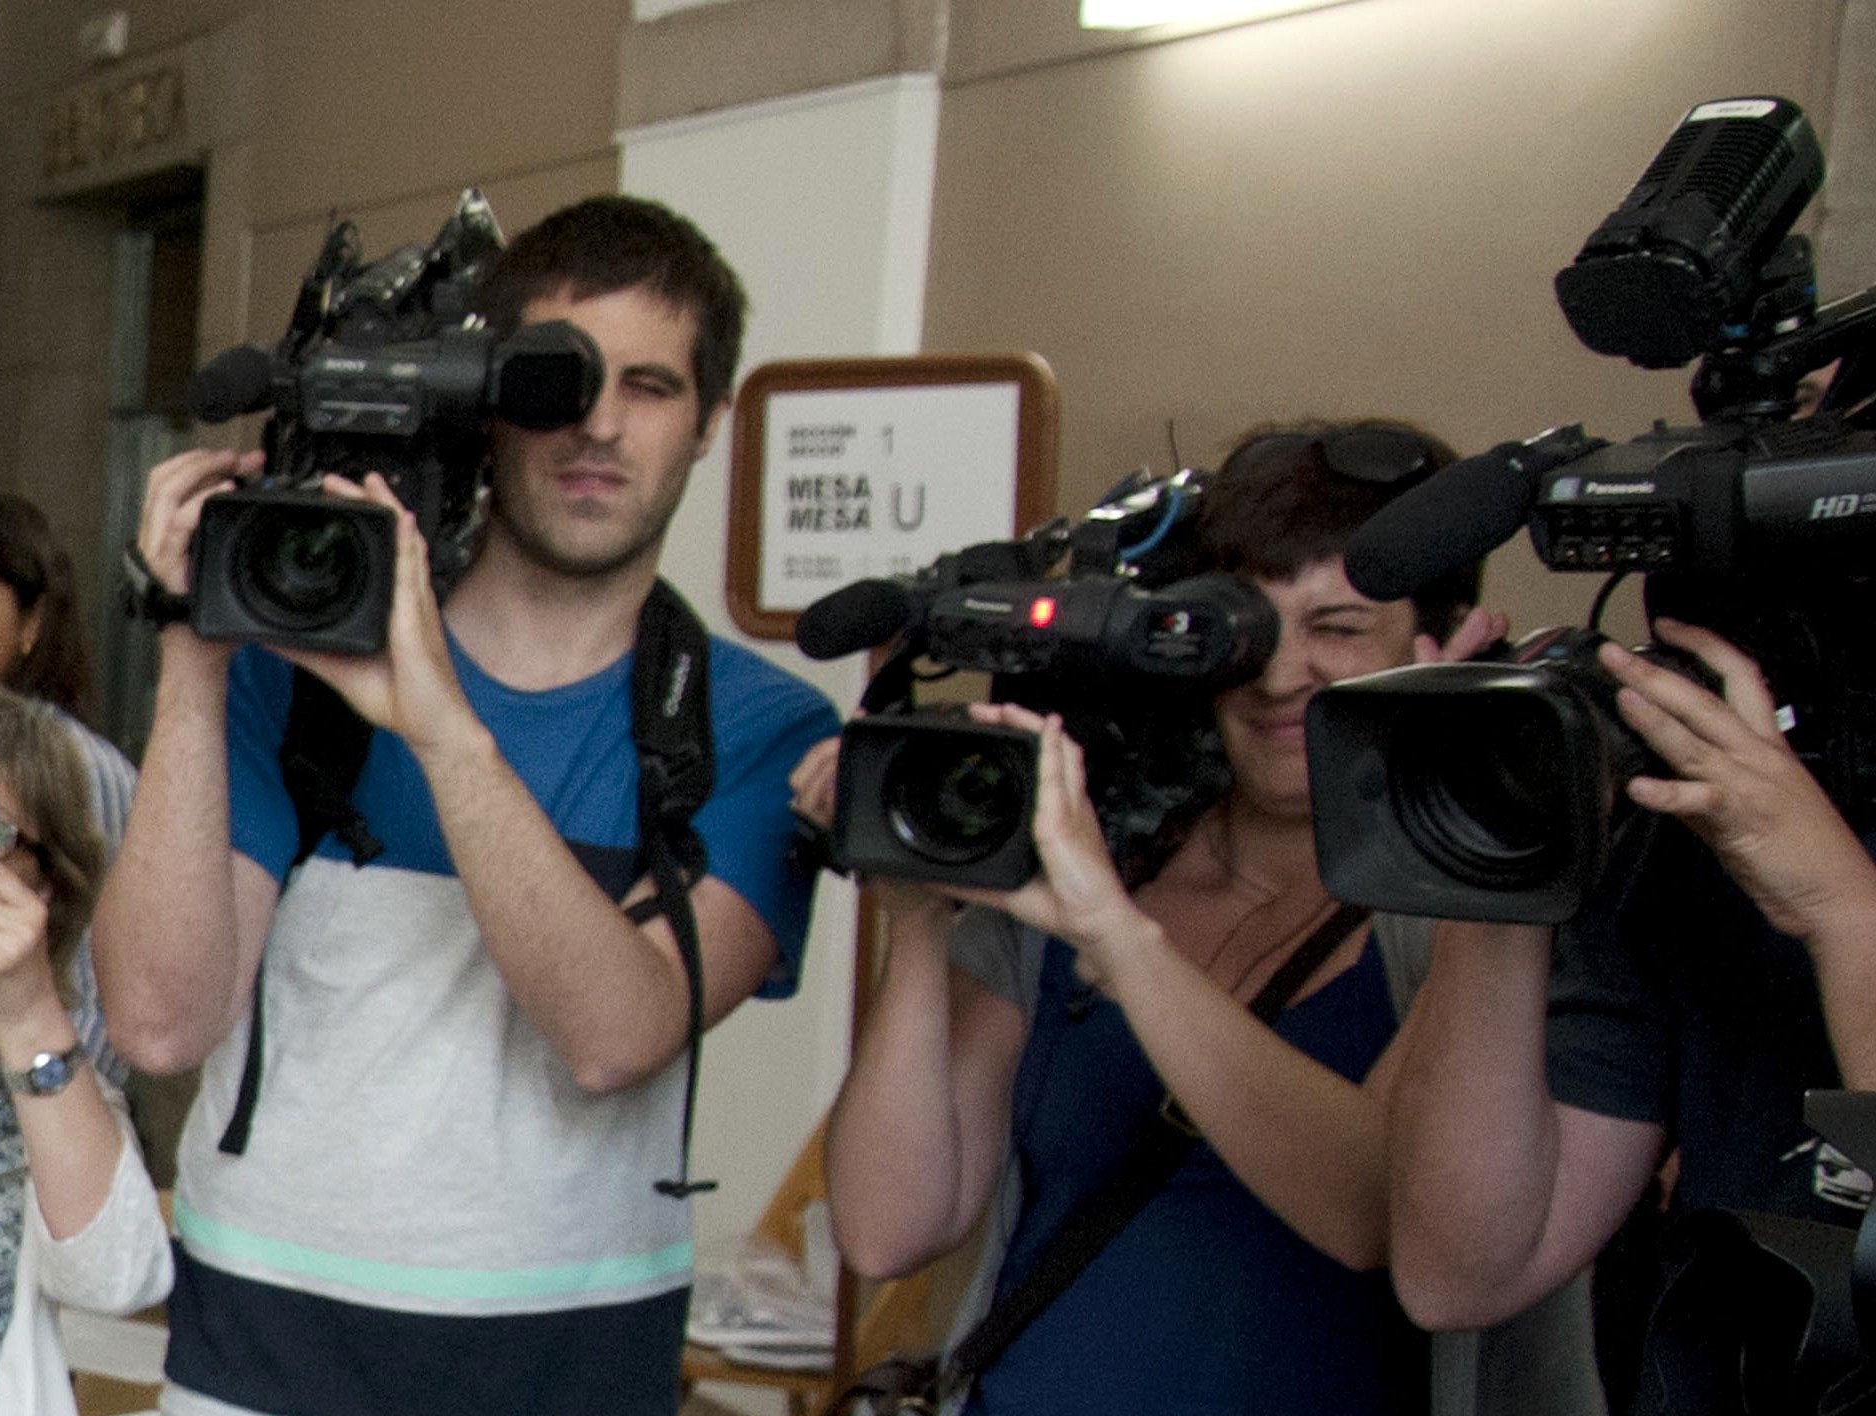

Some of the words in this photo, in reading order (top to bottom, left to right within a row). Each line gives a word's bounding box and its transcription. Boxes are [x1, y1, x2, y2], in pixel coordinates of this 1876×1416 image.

[788, 476, 871, 500] MESA
[1585, 481, 1655, 494] Panasonic
[788, 506, 871, 531] MESA
[893, 484, 925, 531] U
[1811, 494, 1859, 519] HD
